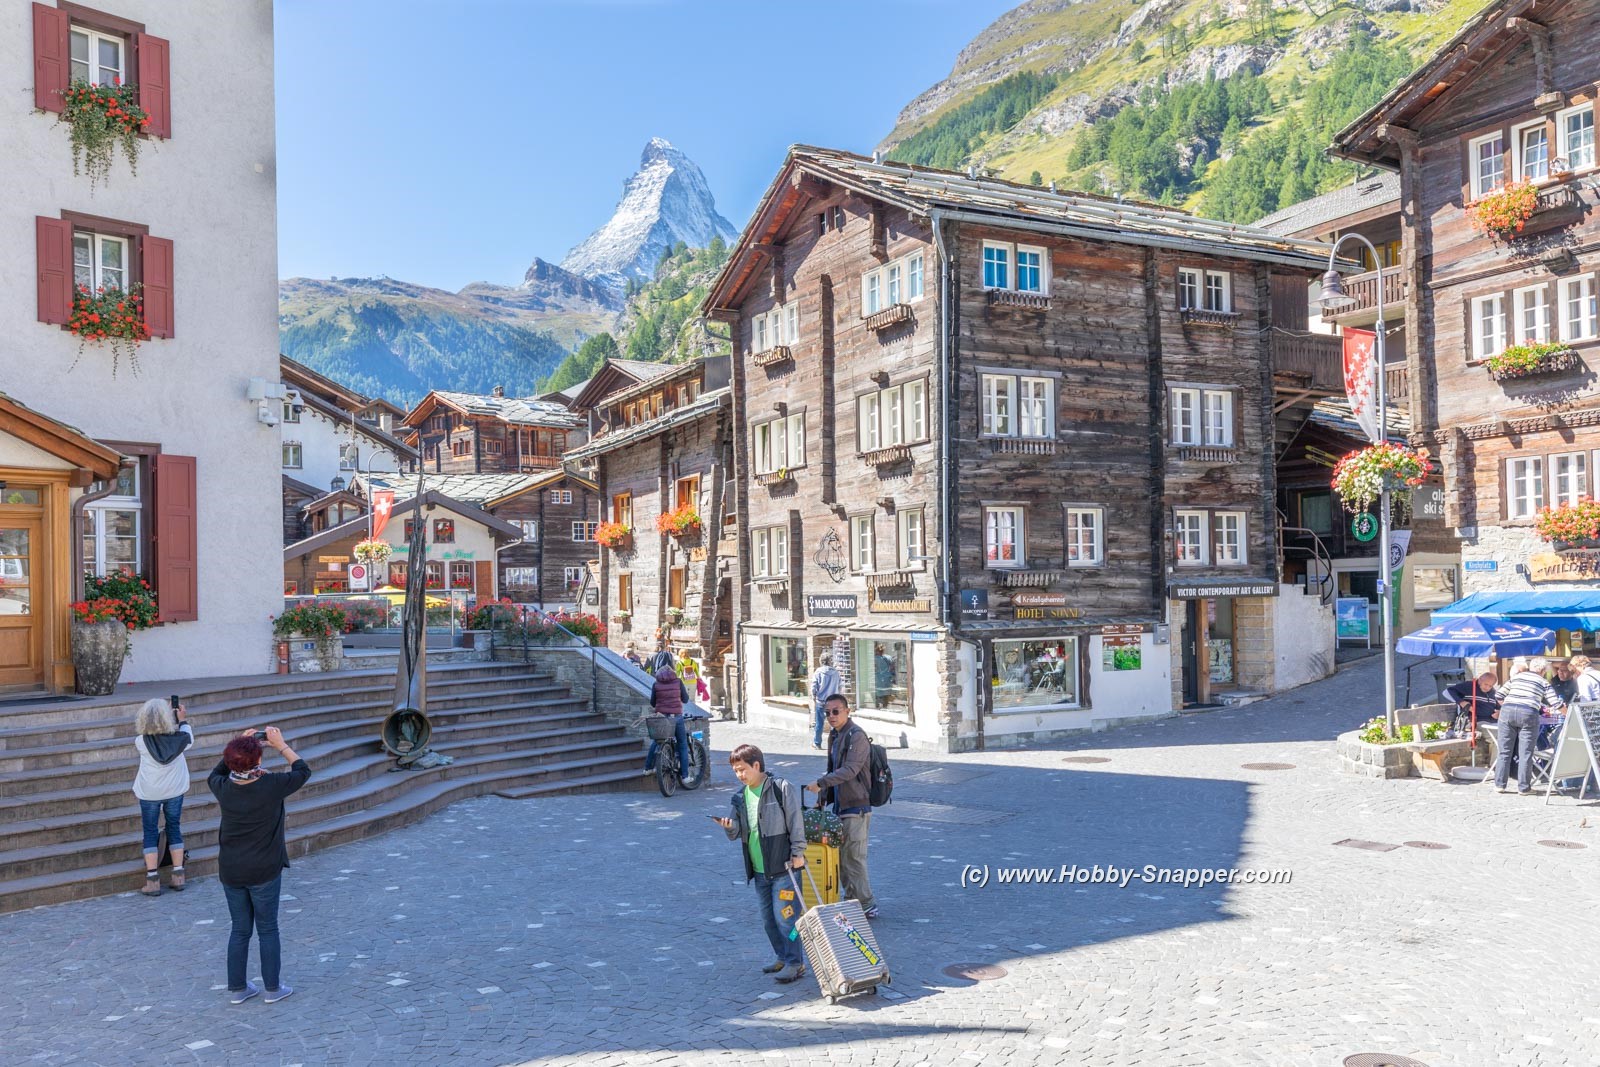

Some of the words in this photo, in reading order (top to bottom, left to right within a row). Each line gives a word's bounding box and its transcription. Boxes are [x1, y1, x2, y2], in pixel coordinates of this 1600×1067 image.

[1424, 501, 1437, 514] ski
[1438, 504, 1446, 515] s
[1543, 561, 1588, 577] WILDE
[1177, 588, 1197, 597] VICTOR
[1197, 587, 1240, 596] CONTEMPORARY
[1240, 586, 1251, 595] ART
[1251, 585, 1274, 594] GALLERY
[814, 598, 855, 609] MARCOPOLO
[1017, 608, 1044, 619] HOTEL
